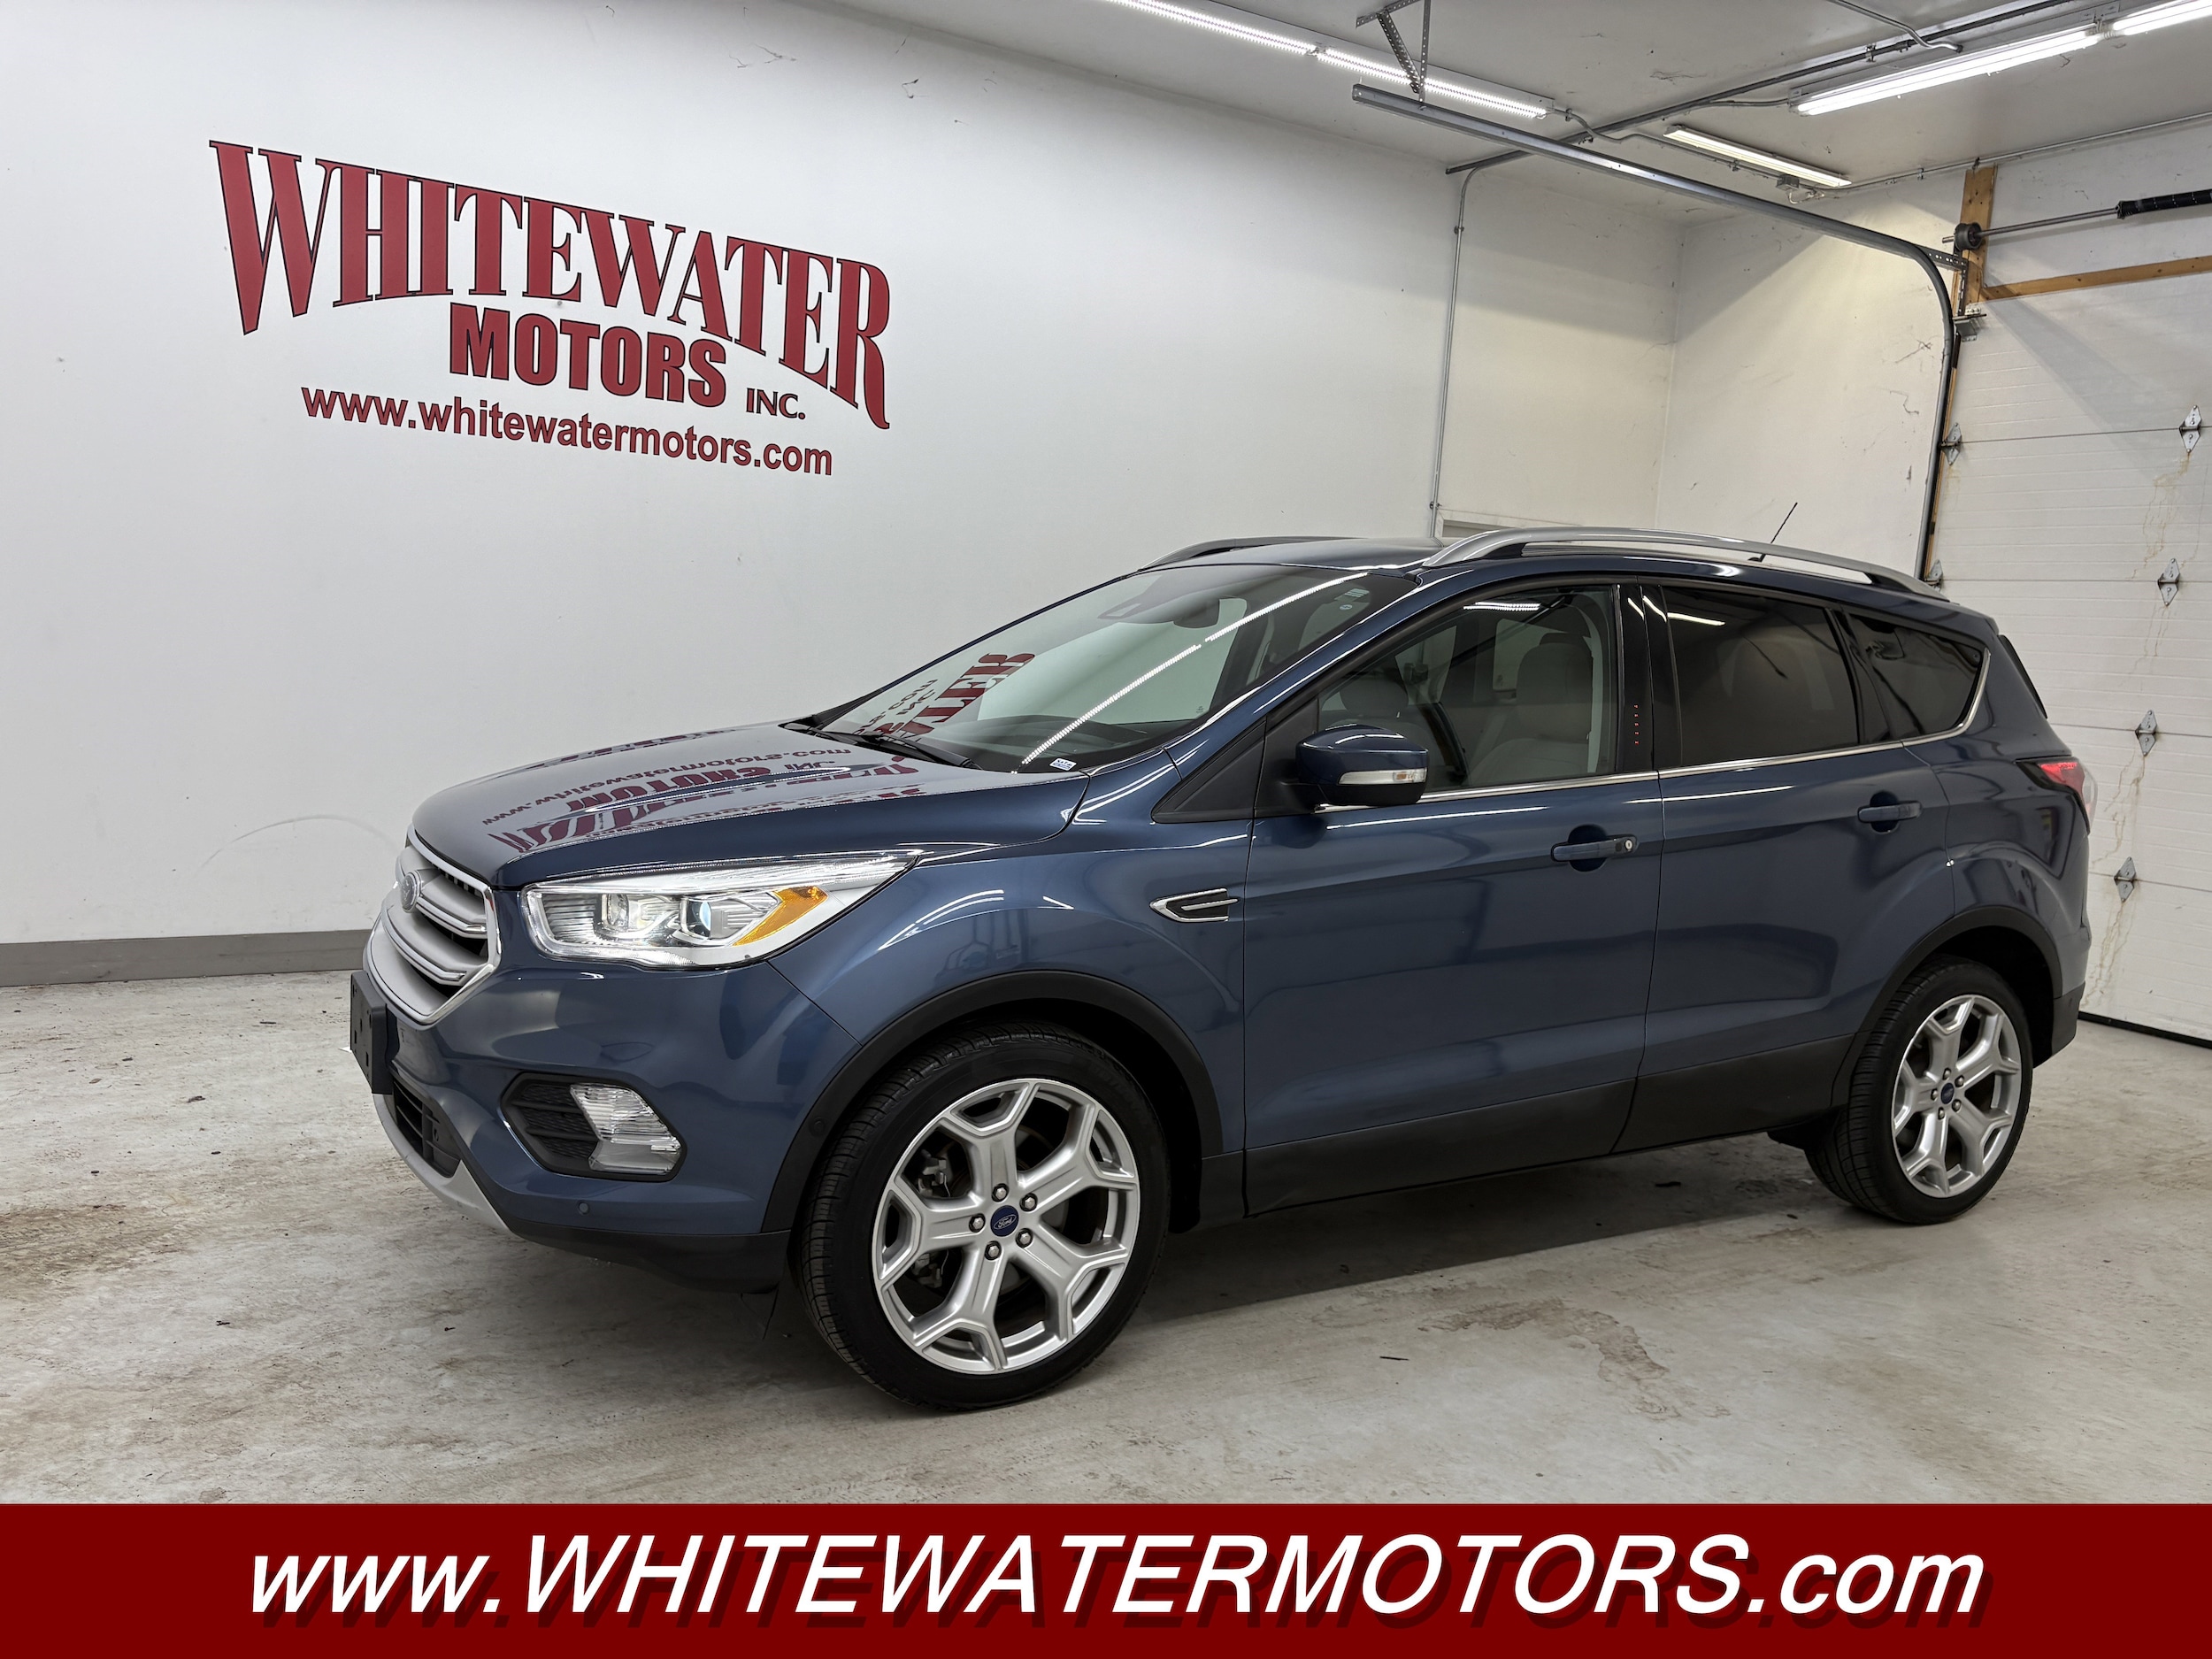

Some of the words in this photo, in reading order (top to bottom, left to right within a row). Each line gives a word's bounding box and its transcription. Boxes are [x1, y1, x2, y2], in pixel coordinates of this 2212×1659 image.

[210, 140, 890, 430] WHITEWATER
[450, 303, 726, 408] MOTORS
[747, 388, 806, 420] INC.
[301, 388, 833, 476] www.whitewatermotors.com
